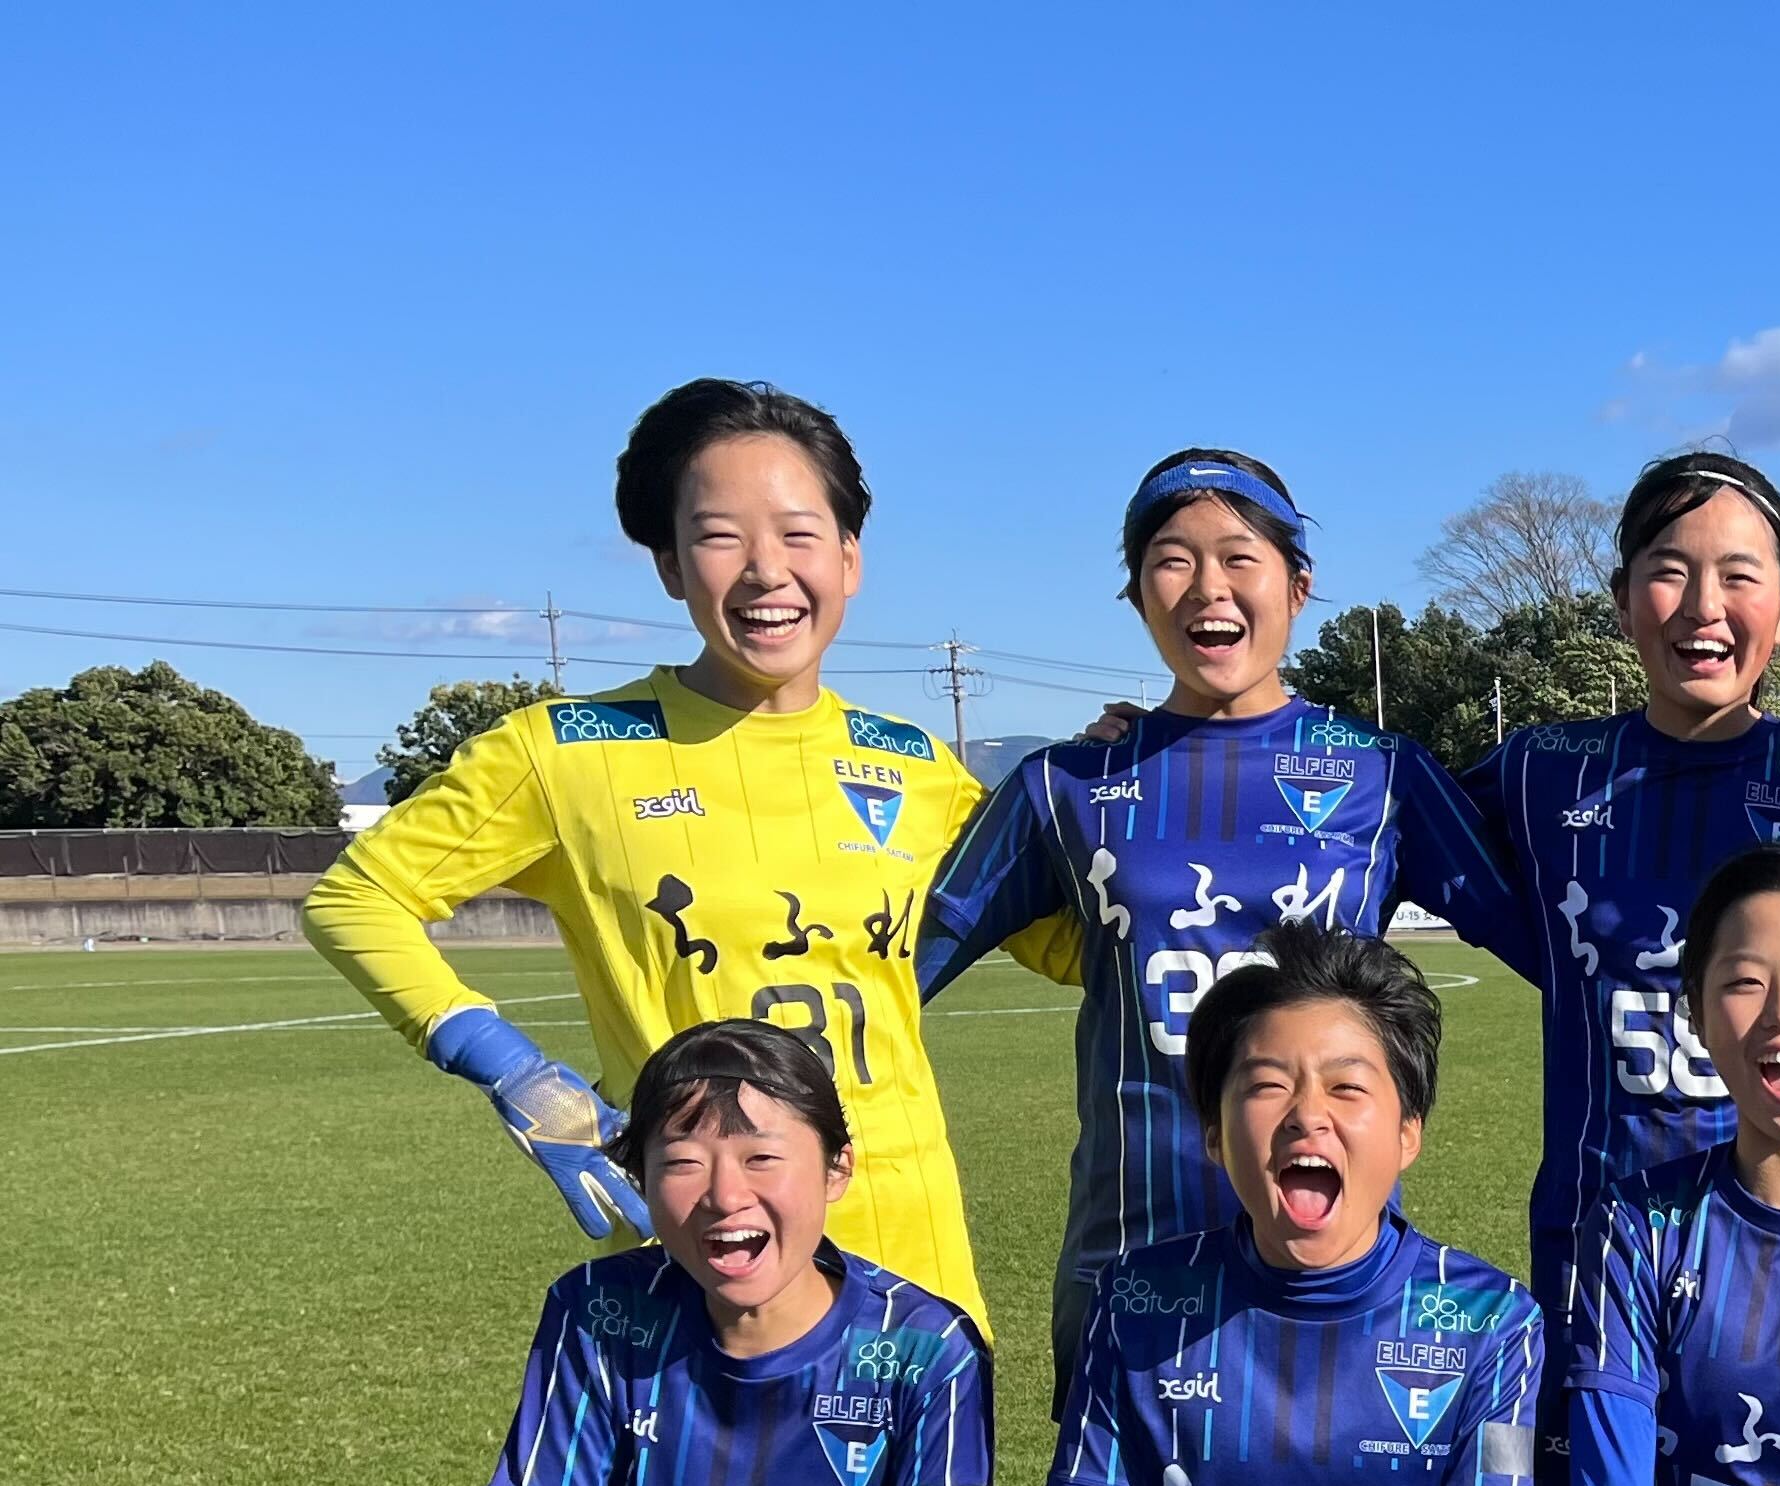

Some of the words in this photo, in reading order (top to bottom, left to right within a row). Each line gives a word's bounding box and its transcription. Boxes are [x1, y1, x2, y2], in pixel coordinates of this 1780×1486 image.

[557, 704, 597, 725] do
[560, 712, 660, 741] natural
[849, 713, 879, 737] do
[1311, 719, 1347, 734] do
[853, 730, 932, 759] natural
[1310, 729, 1398, 752] natural
[1525, 730, 1607, 754] natural
[833, 759, 903, 786] ELFEN
[1274, 753, 1355, 778] ELFEN
[1113, 1269, 1151, 1297] do
[1110, 1284, 1204, 1316] natural
[1421, 1285, 1457, 1314] do
[1418, 1309, 1500, 1332] natur
[858, 1336, 896, 1360] do
[1376, 1340, 1467, 1370] ELFEN
